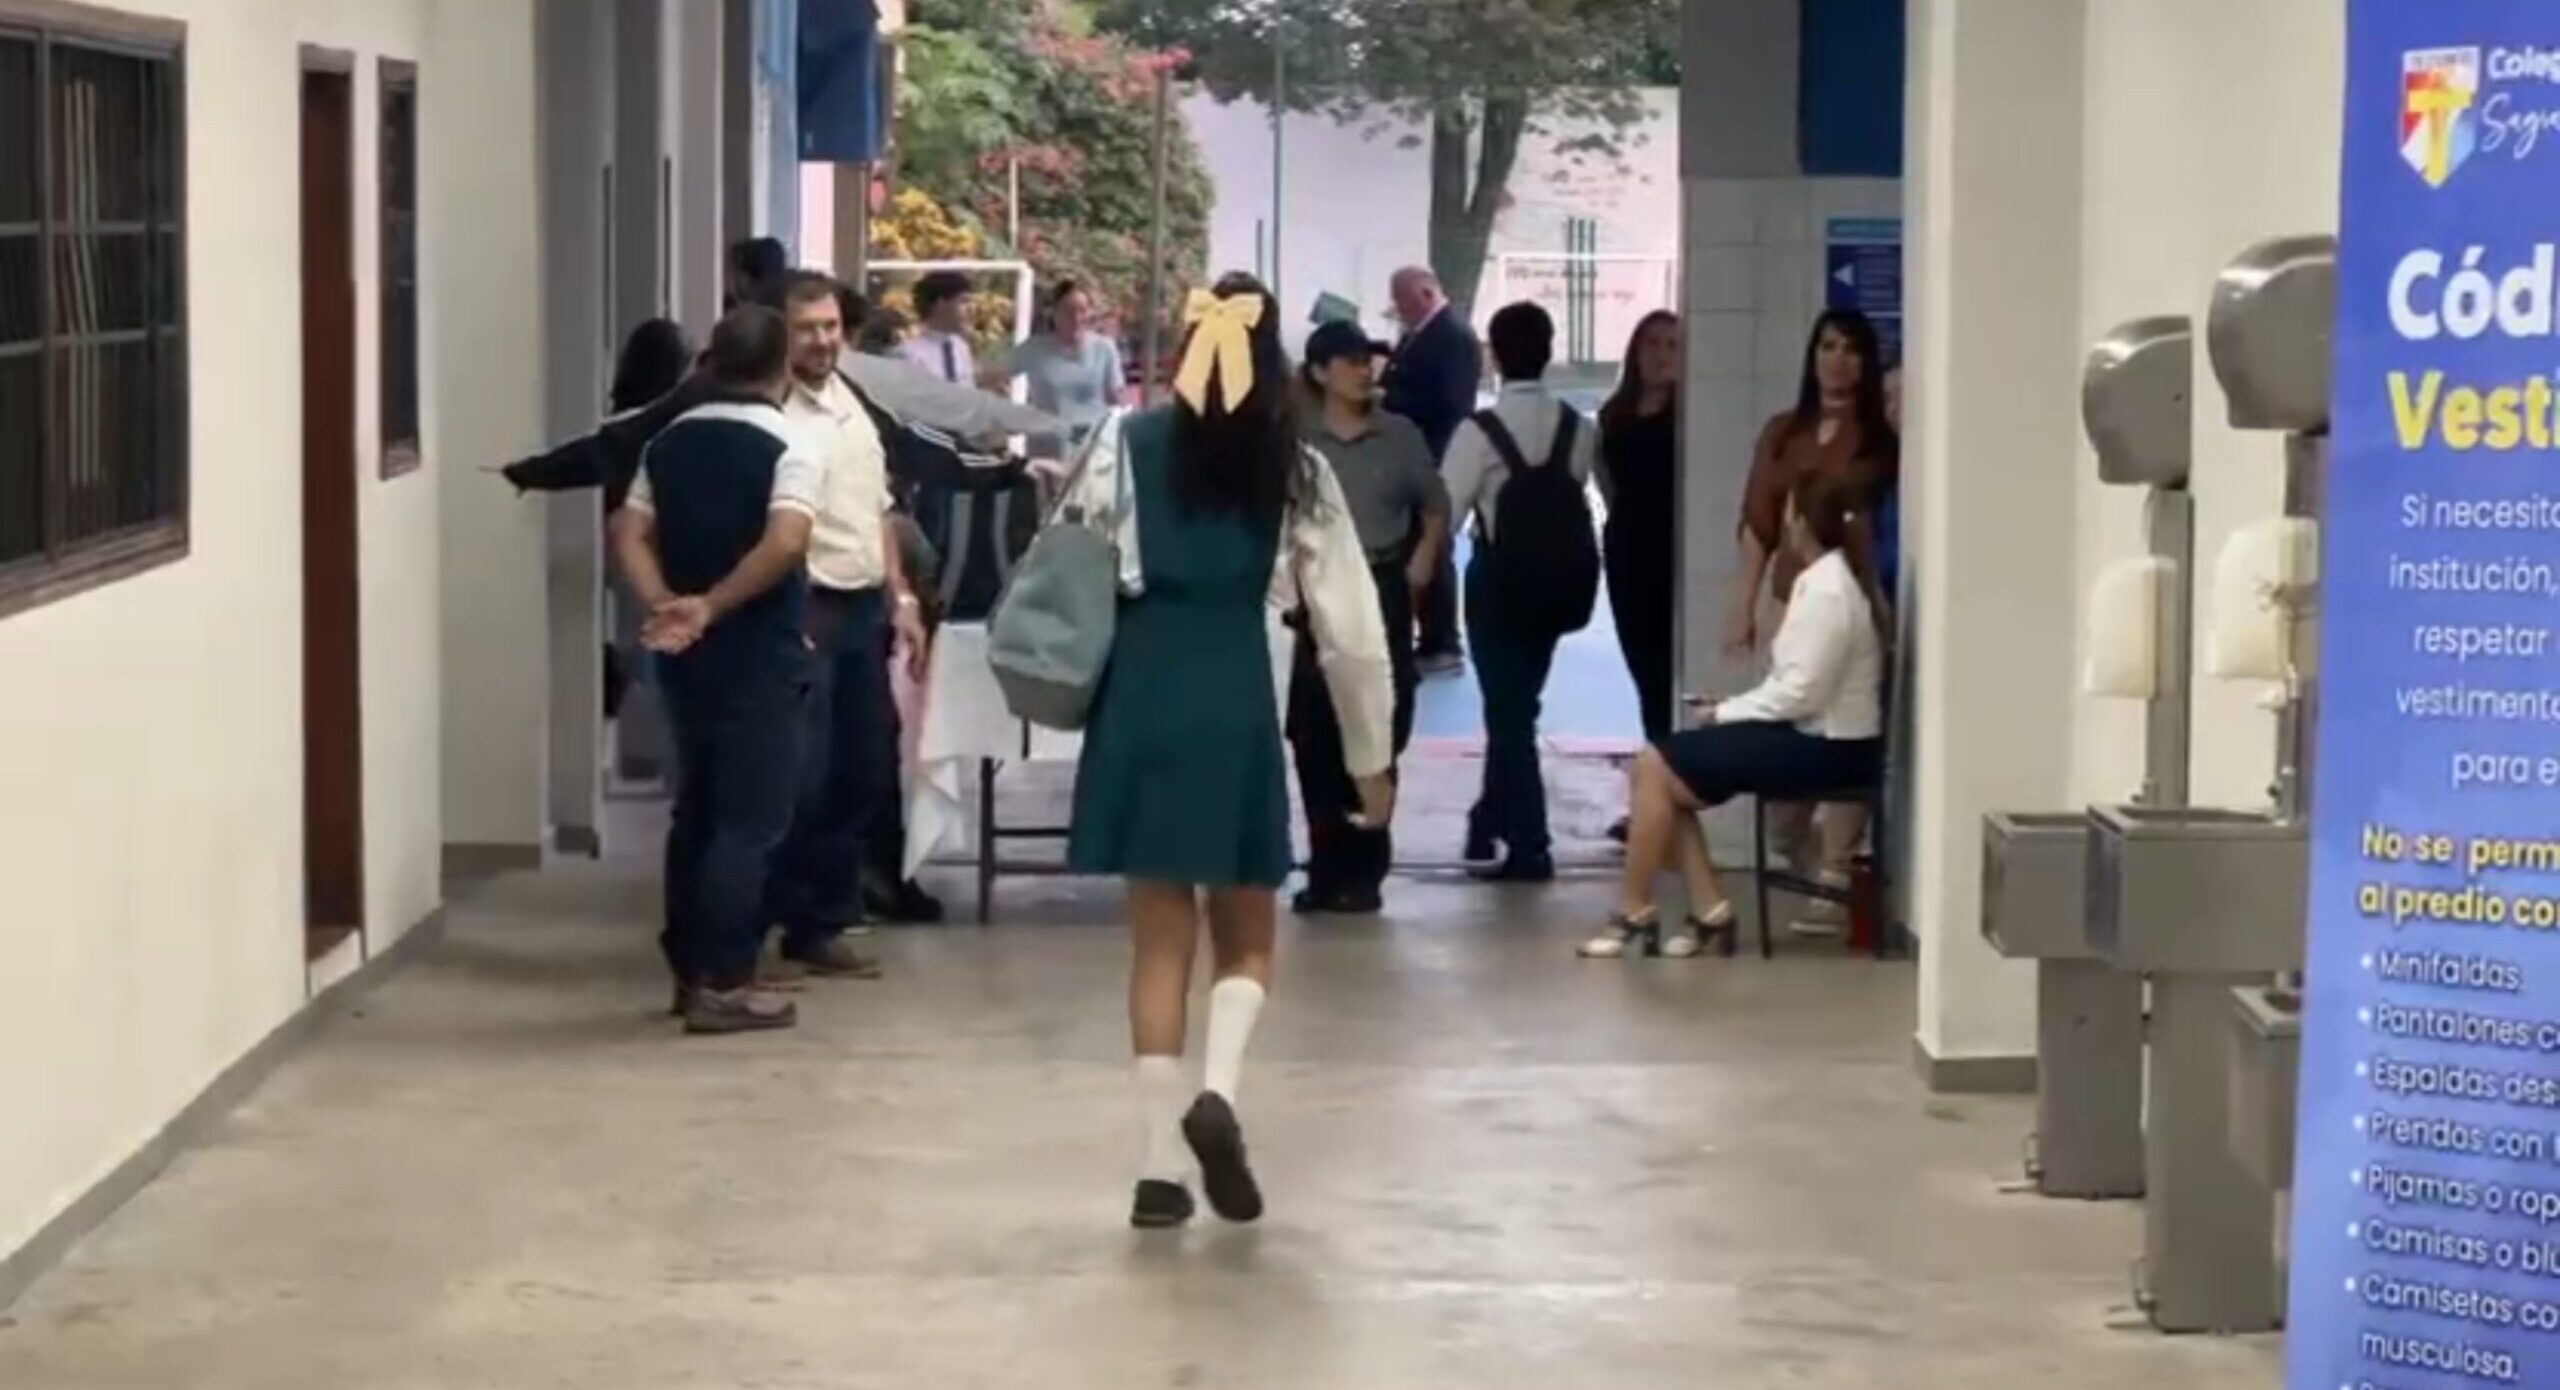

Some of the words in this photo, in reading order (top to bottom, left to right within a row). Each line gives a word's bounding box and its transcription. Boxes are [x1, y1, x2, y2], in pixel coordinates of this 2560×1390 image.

[2387, 243, 2560, 340] Cód
[2402, 493, 2428, 527] Si
[2390, 553, 2558, 598] institución,
[2414, 624, 2549, 663] respetar
[2453, 752, 2529, 788] para
[2362, 822, 2402, 859] No
[2415, 832, 2453, 862] se
[2360, 881, 2388, 912] al
[2395, 885, 2505, 925] predio
[2513, 897, 2560, 928] co
[2377, 1003, 2529, 1046] Pantalones
[2374, 1057, 2498, 1098] Espaldas
[2371, 1111, 2484, 1151] Prendas
[2491, 1130, 2543, 1158] con
[2368, 1164, 2478, 1206] Pijamas
[2484, 1185, 2503, 1209] o
[2366, 1218, 2488, 1264] Camisas
[2494, 1243, 2513, 1268] o
[2363, 1273, 2513, 1323] Camisetas
